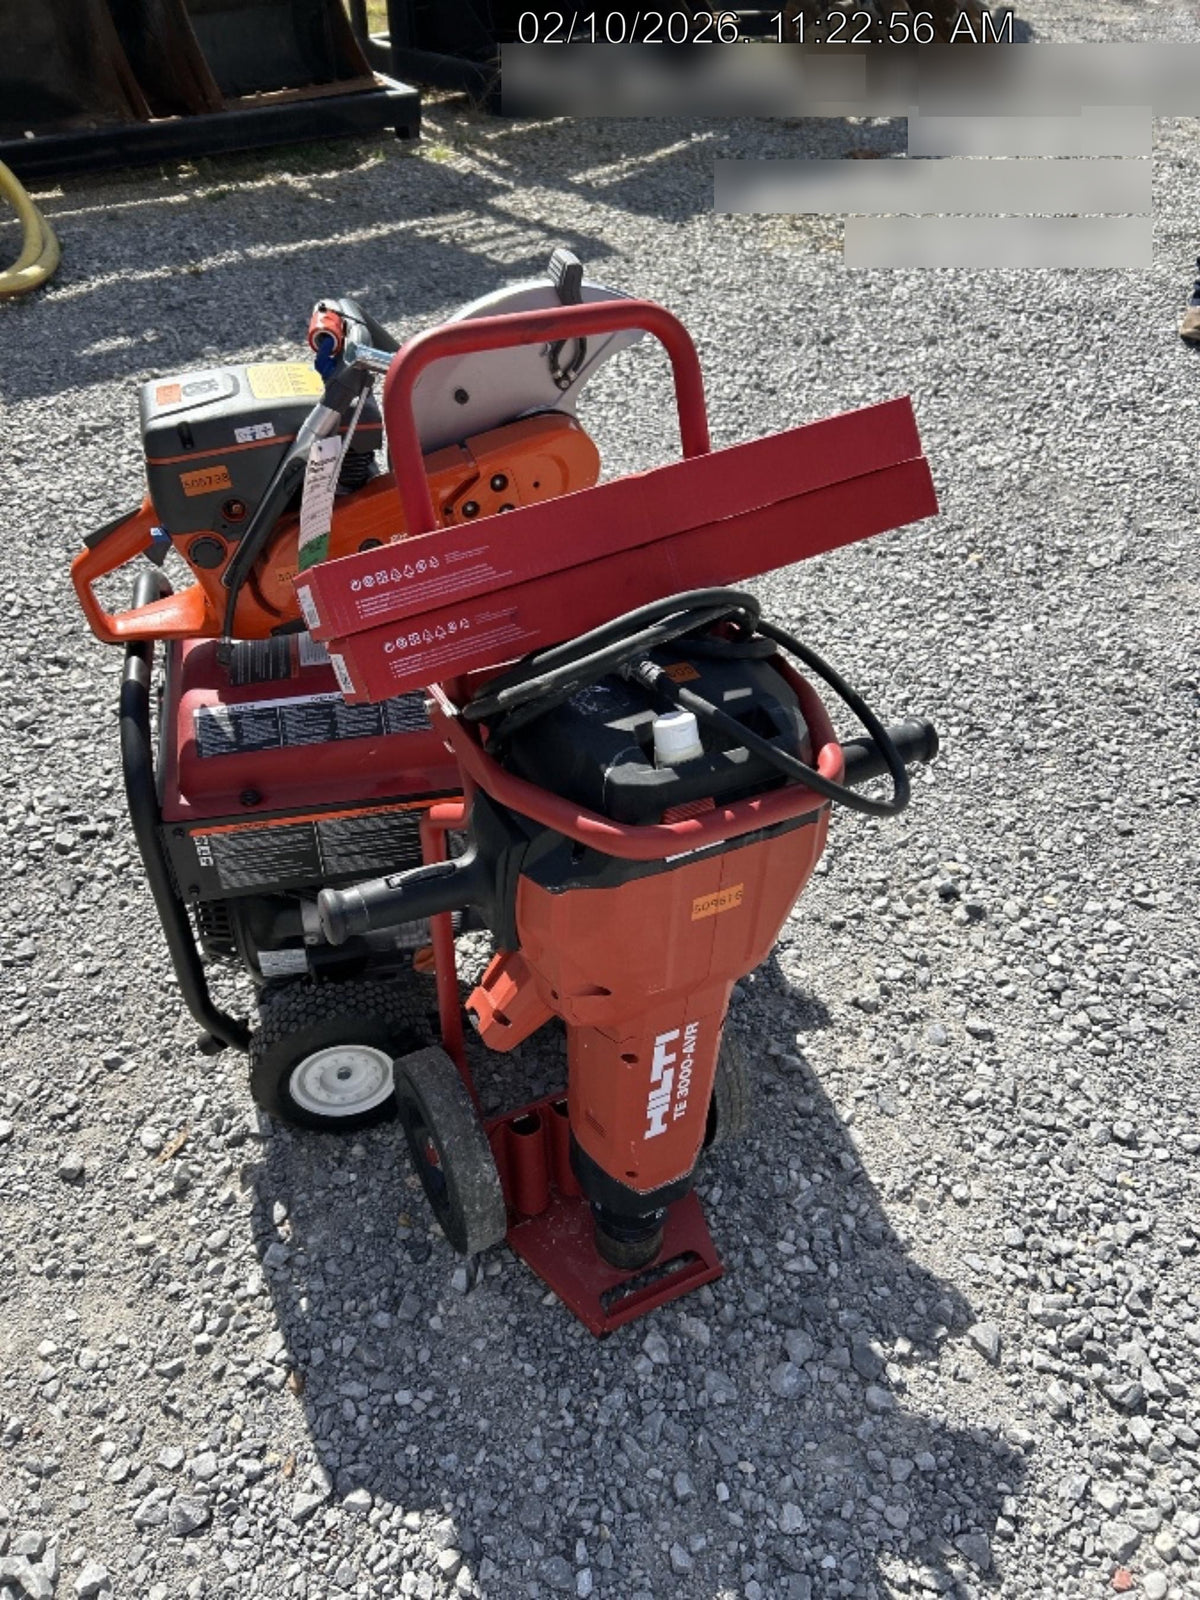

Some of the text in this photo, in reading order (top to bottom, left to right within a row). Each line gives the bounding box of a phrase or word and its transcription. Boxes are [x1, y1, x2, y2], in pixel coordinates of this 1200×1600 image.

[643, 1028, 680, 1140] HILTI
[673, 1021, 700, 1121] TE 3000-AVR
